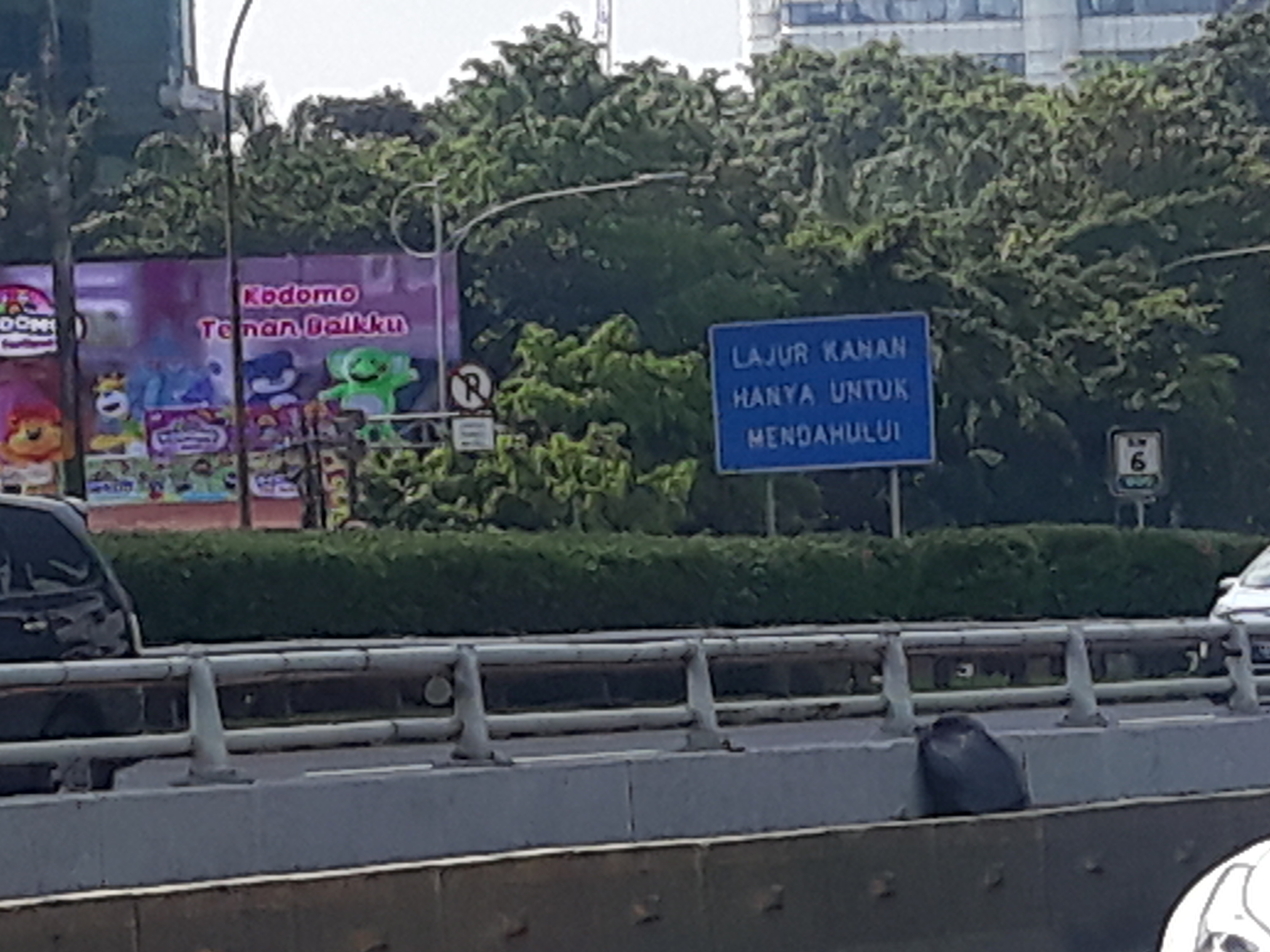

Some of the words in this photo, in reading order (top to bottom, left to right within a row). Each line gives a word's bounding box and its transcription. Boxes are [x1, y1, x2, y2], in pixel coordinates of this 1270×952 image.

[243, 284, 358, 306] Kodomo
[732, 342, 809, 369] LAJUR
[822, 336, 907, 362] KANAN
[733, 383, 815, 409] HANYA
[830, 378, 909, 405] UNTUK
[747, 420, 900, 449] MENDAHULUI
[1131, 451, 1146, 472] 6
